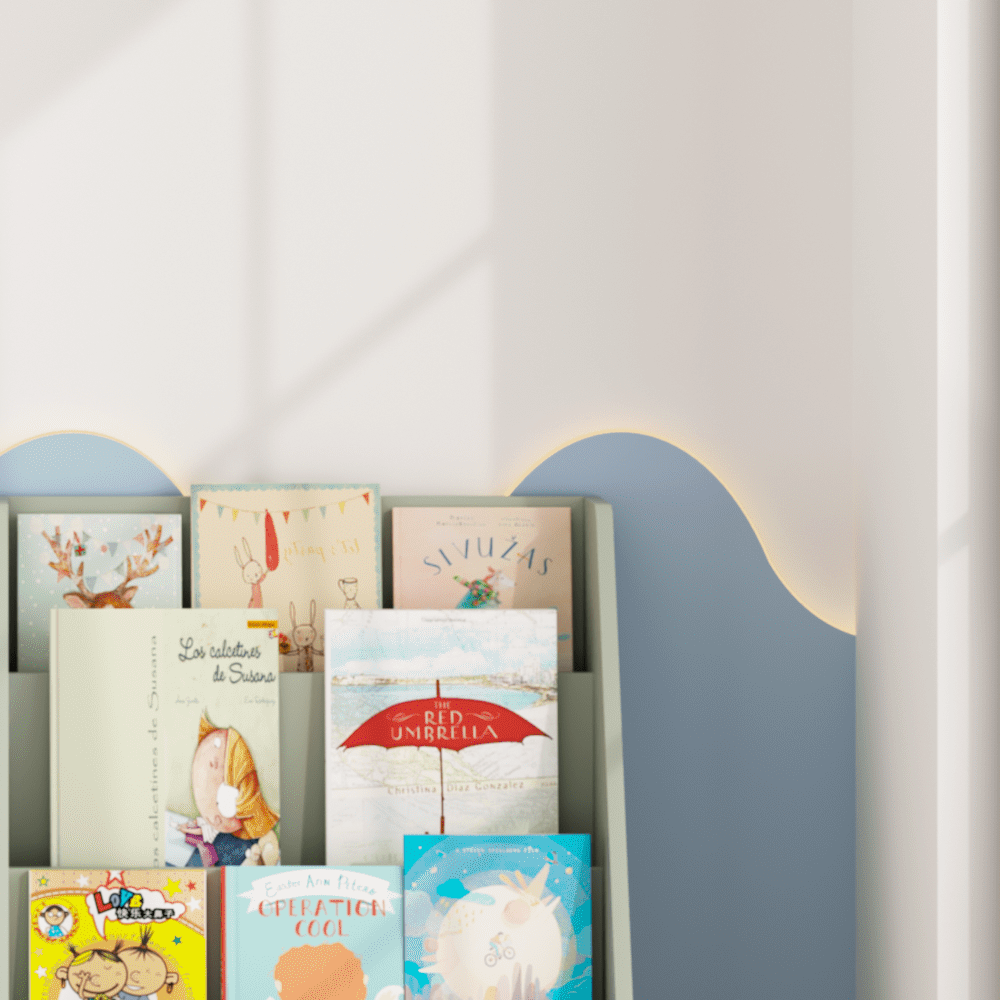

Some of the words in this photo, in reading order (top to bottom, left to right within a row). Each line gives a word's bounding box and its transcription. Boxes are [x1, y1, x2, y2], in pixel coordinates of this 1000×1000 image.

[423, 535, 553, 576] SIVUŽAS
[178, 637, 206, 662] Los
[209, 639, 261, 659] calcetines
[148, 635, 160, 711] Susana
[212, 664, 226, 682] de
[229, 662, 276, 684] Susana
[424, 710, 463, 725] RED
[148, 718, 158, 741] de
[391, 725, 499, 743] UMBRELLA
[387, 784, 437, 795] Christina
[258, 898, 386, 917] OPERATION
[295, 919, 349, 938] COOL
